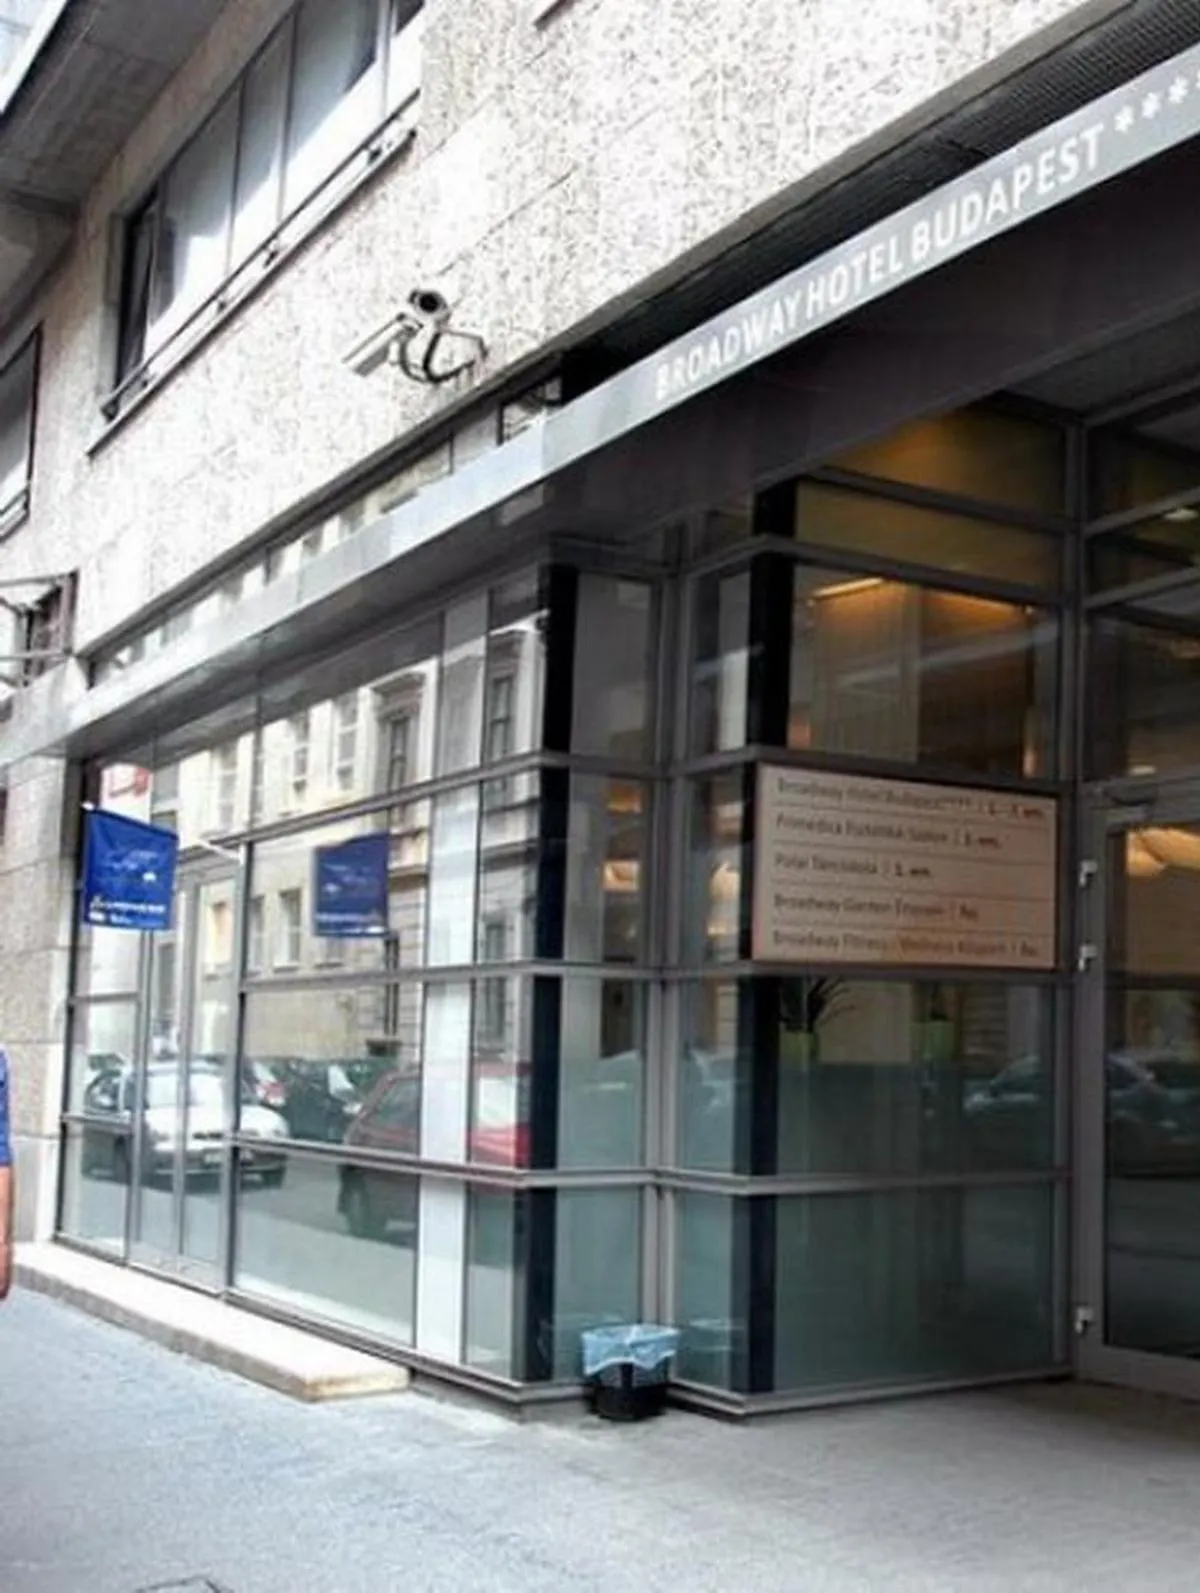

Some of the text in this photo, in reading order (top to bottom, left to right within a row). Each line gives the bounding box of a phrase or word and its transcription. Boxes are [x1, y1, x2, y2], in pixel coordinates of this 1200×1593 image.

[656, 289, 802, 401] BROADWAY
[806, 236, 902, 320] HOTEL
[910, 123, 1104, 264] BUDAPEST
